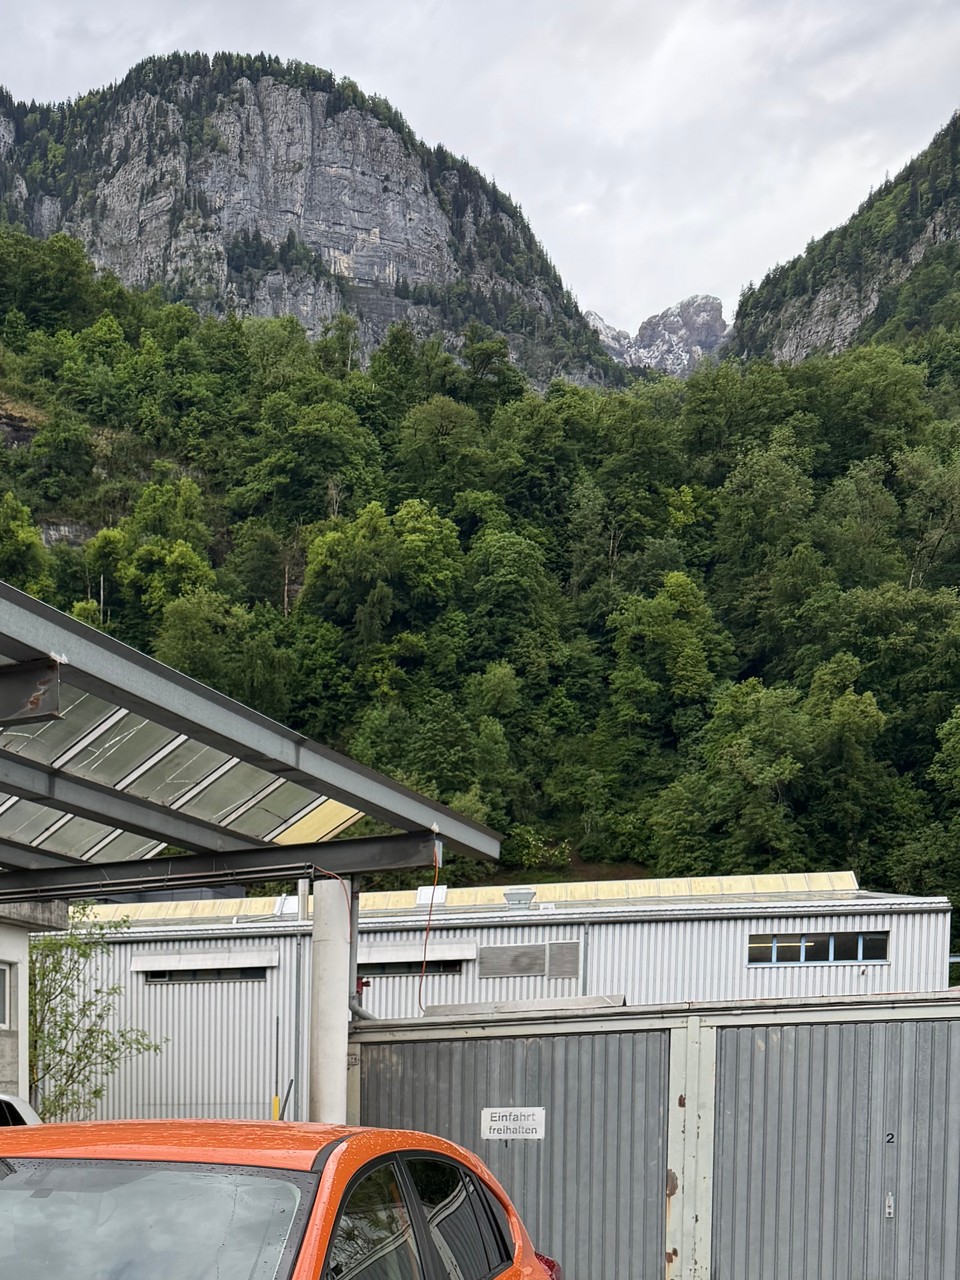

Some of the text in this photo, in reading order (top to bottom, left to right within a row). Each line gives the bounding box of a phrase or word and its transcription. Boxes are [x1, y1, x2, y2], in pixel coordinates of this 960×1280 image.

[490, 1112, 536, 1122] Einfahrt
[489, 1125, 537, 1134] freihalten
[886, 1132, 895, 1144] 2
